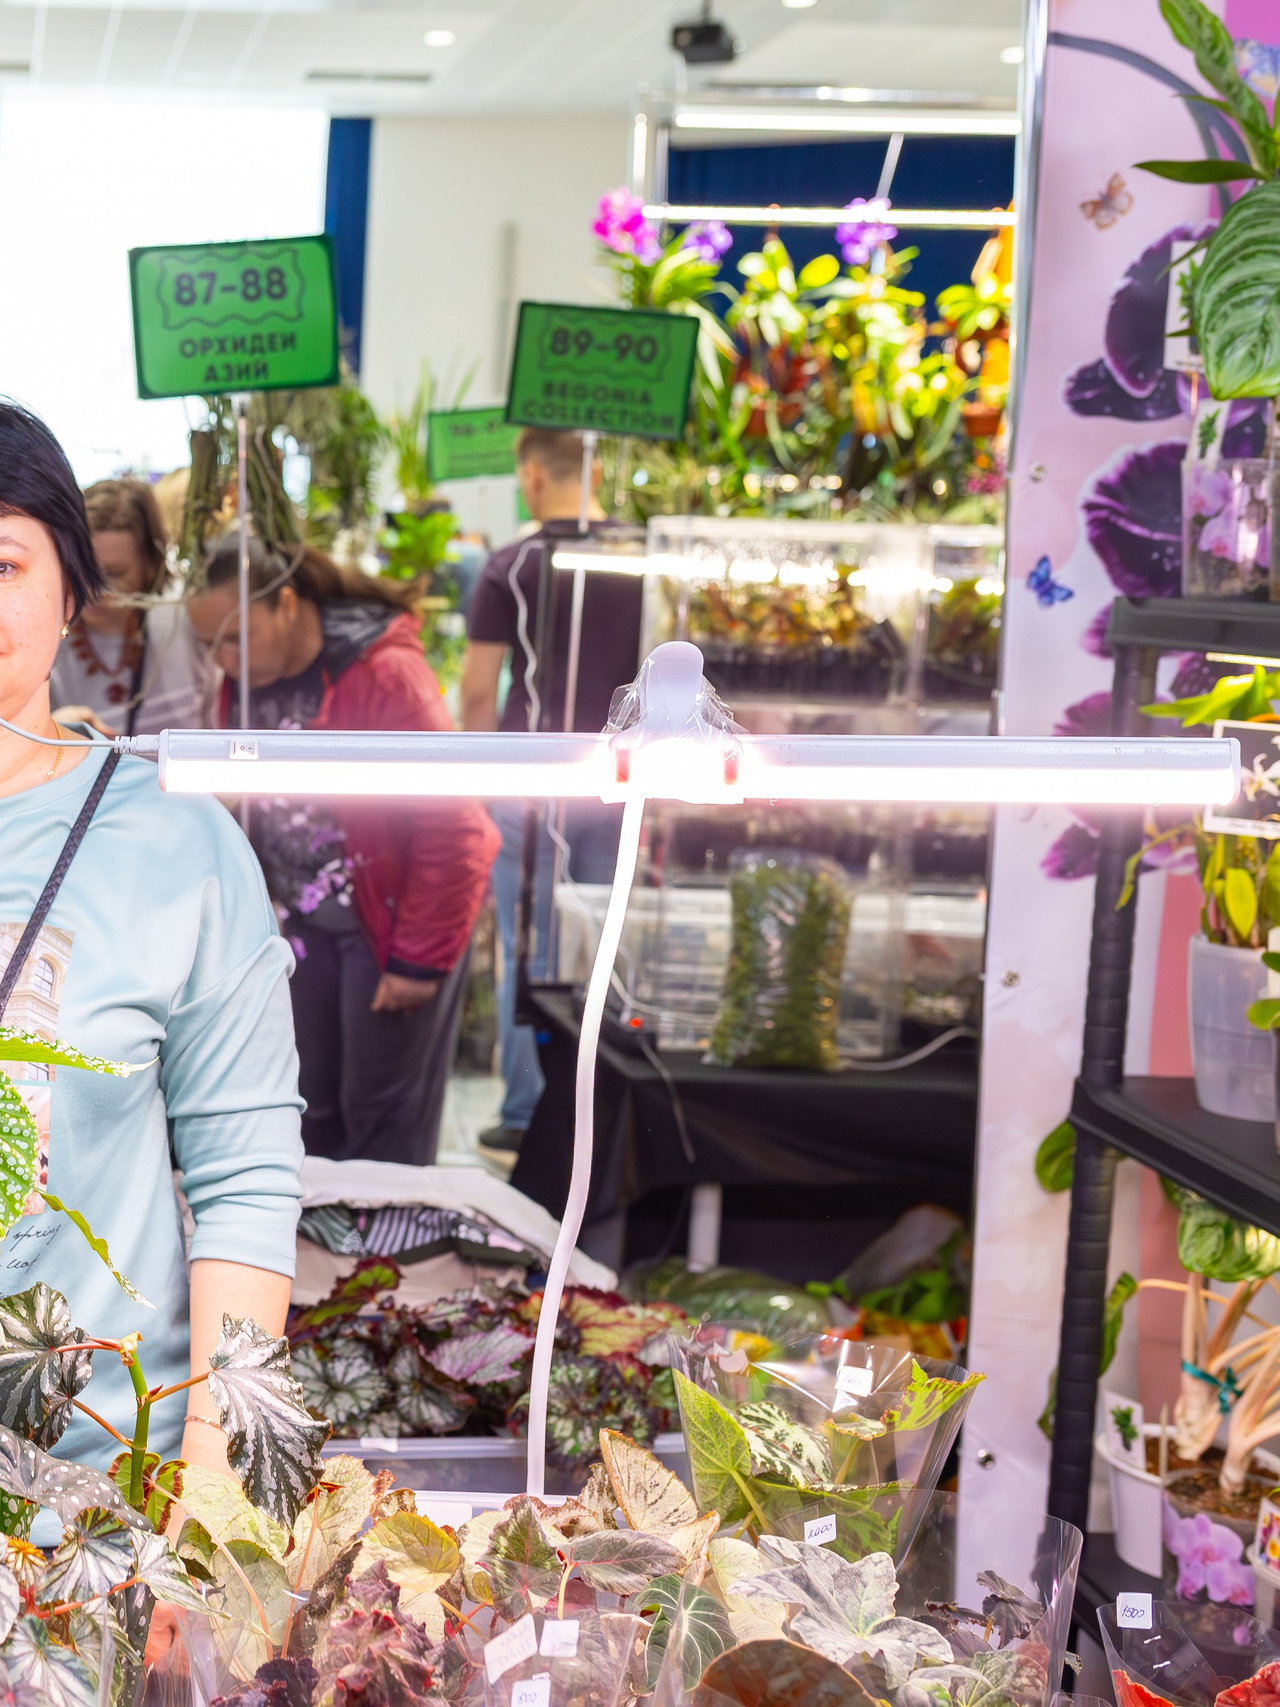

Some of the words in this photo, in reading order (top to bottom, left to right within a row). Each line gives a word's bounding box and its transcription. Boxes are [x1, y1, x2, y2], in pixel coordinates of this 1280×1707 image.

[174, 267, 287, 306] 87-88
[179, 332, 297, 358] ОРХИДЕИ
[550, 327, 658, 363] 89-90
[543, 381, 651, 404] BEGONIA
[523, 400, 674, 430] COLLECTION
[1121, 1605, 1145, 1618] 1500
